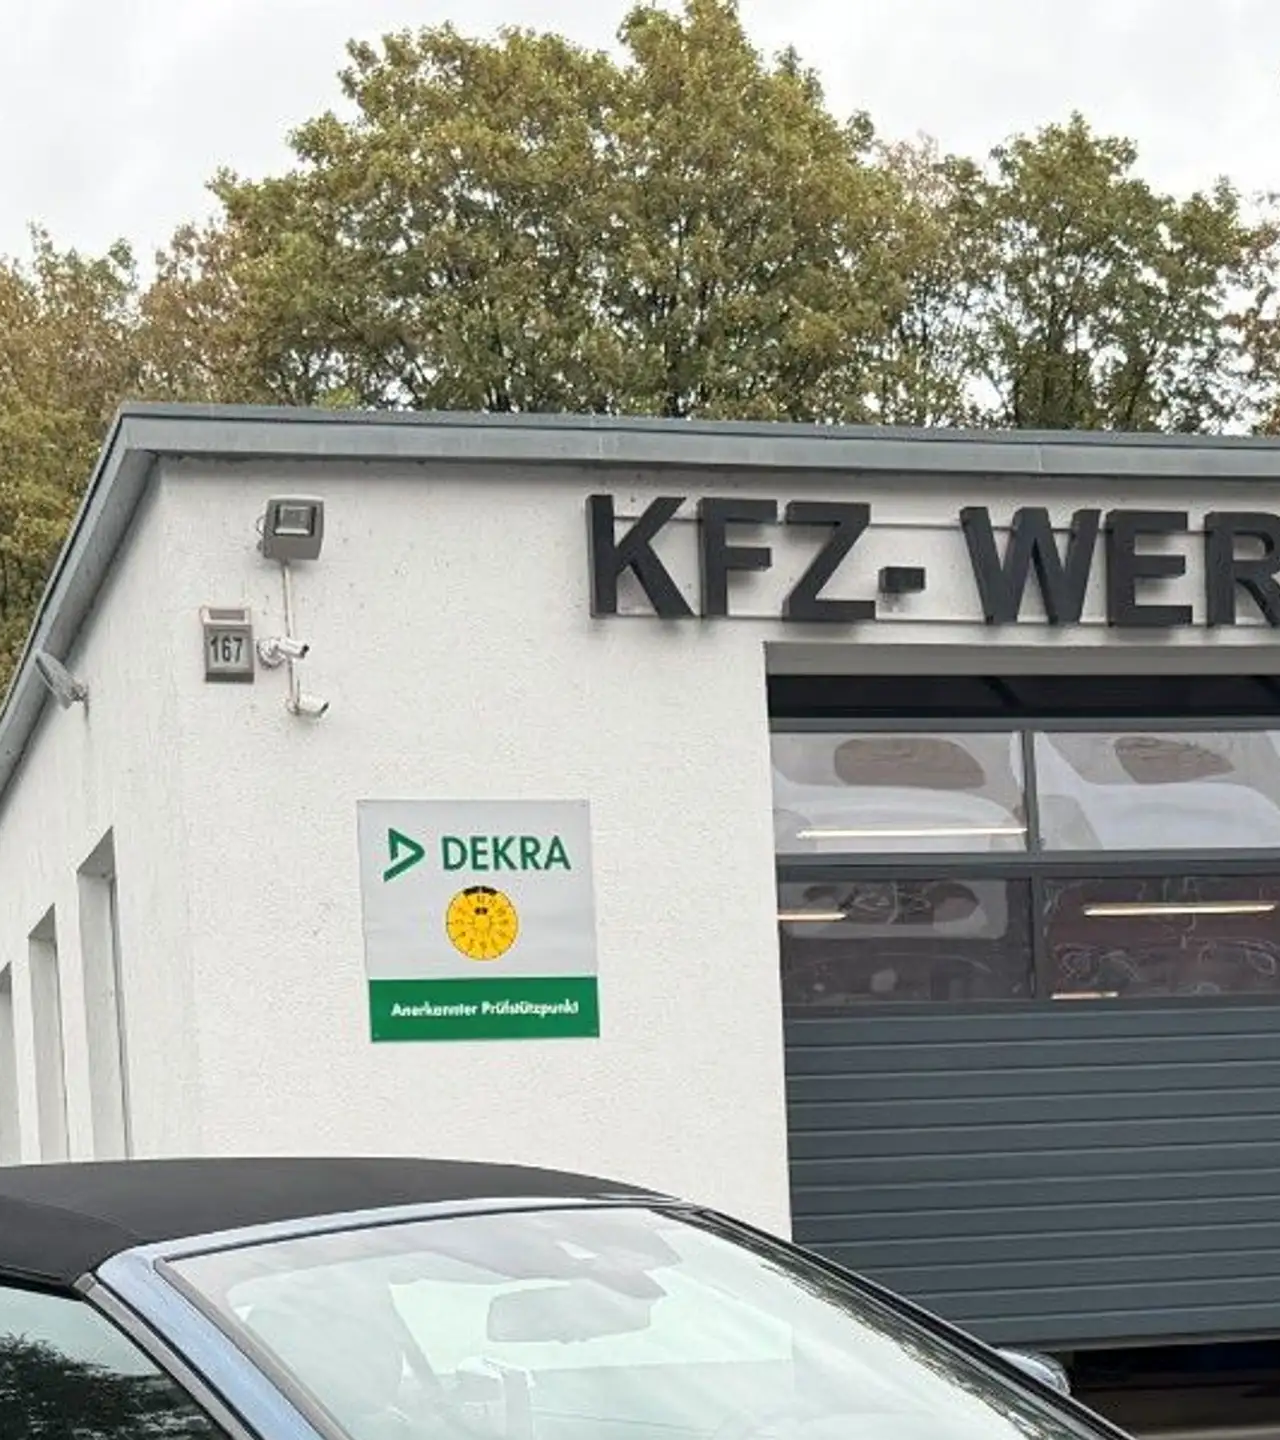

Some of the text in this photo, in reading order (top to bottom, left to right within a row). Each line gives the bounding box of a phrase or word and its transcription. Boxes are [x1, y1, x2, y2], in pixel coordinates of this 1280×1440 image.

[210, 636, 243, 663] 167
[441, 835, 571, 871] DEKRA
[390, 998, 579, 1019] Anerkannter Prüfstützpunkt
